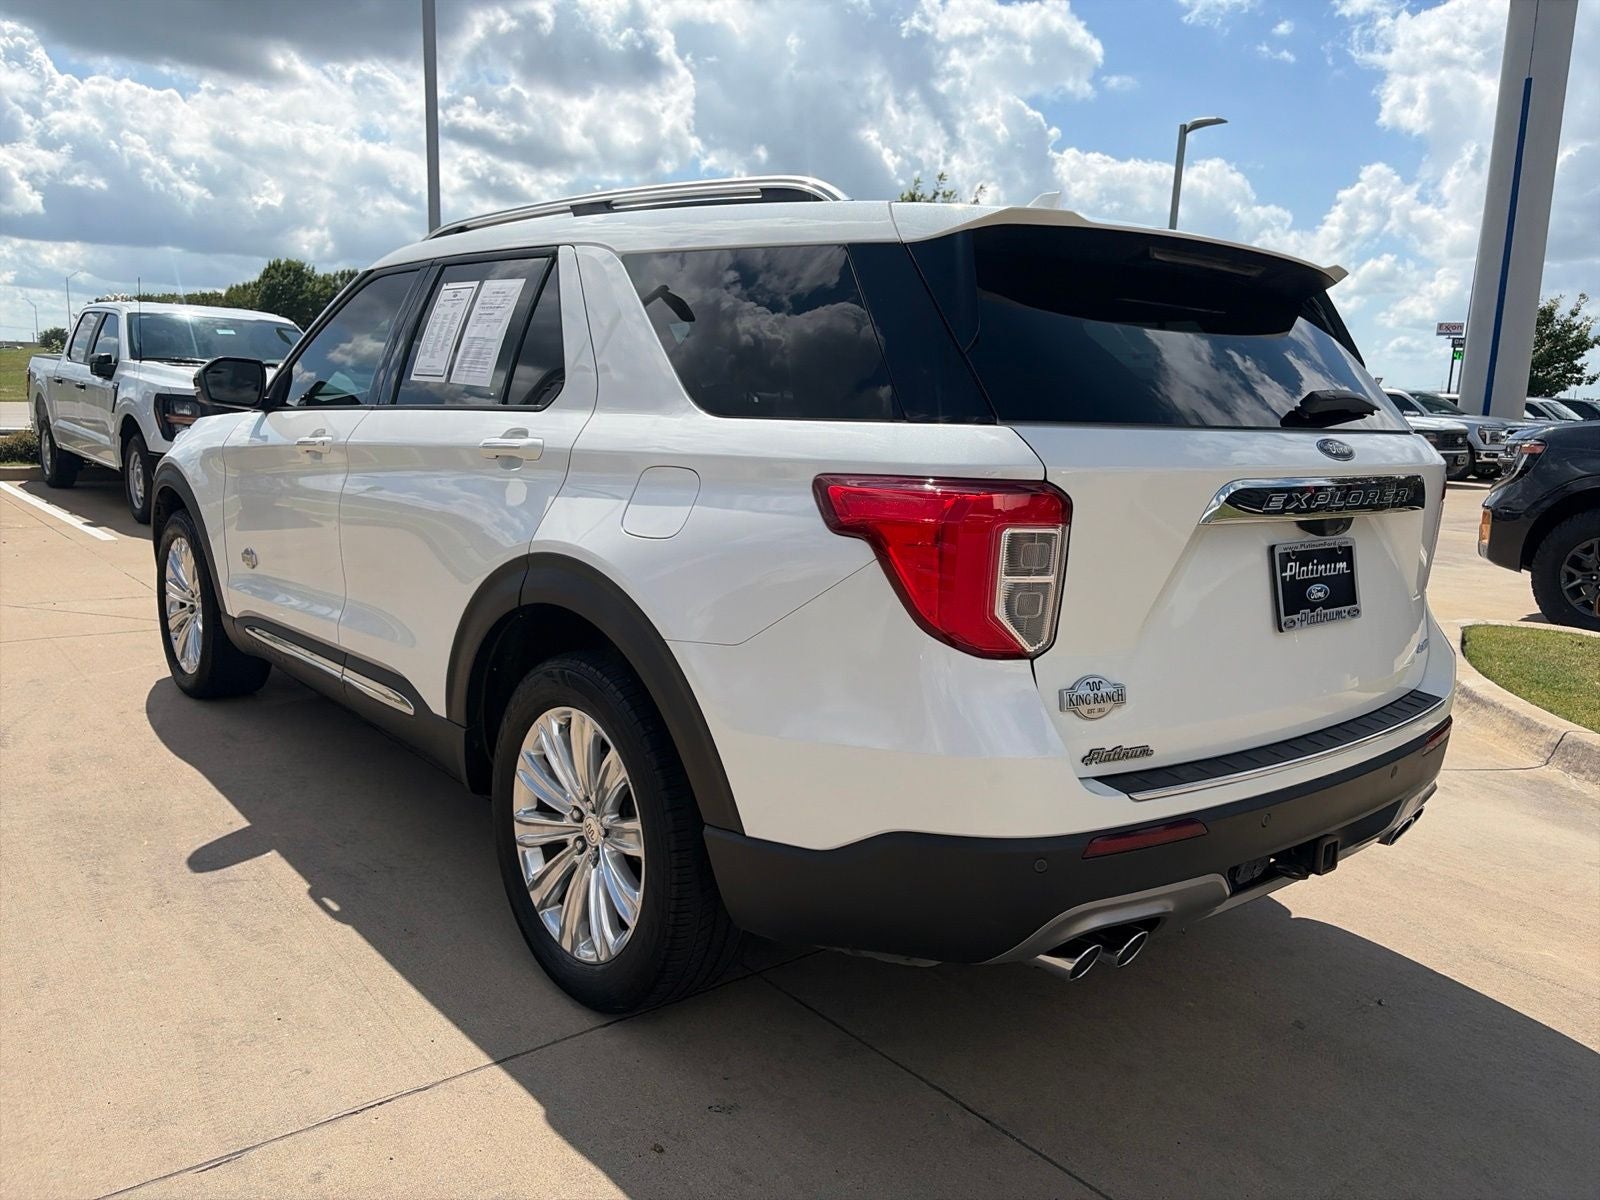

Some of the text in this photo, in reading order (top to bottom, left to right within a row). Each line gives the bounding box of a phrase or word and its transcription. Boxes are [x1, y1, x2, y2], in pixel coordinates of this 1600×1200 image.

[1262, 488, 1408, 510] EXPLORER
[1283, 540, 1349, 551] www.PlatinumFord.com
[1281, 559, 1351, 581] Platinum
[1310, 586, 1326, 600] Ford
[1068, 688, 1124, 707] KING RANCH
[1081, 745, 1154, 766] Platinum
